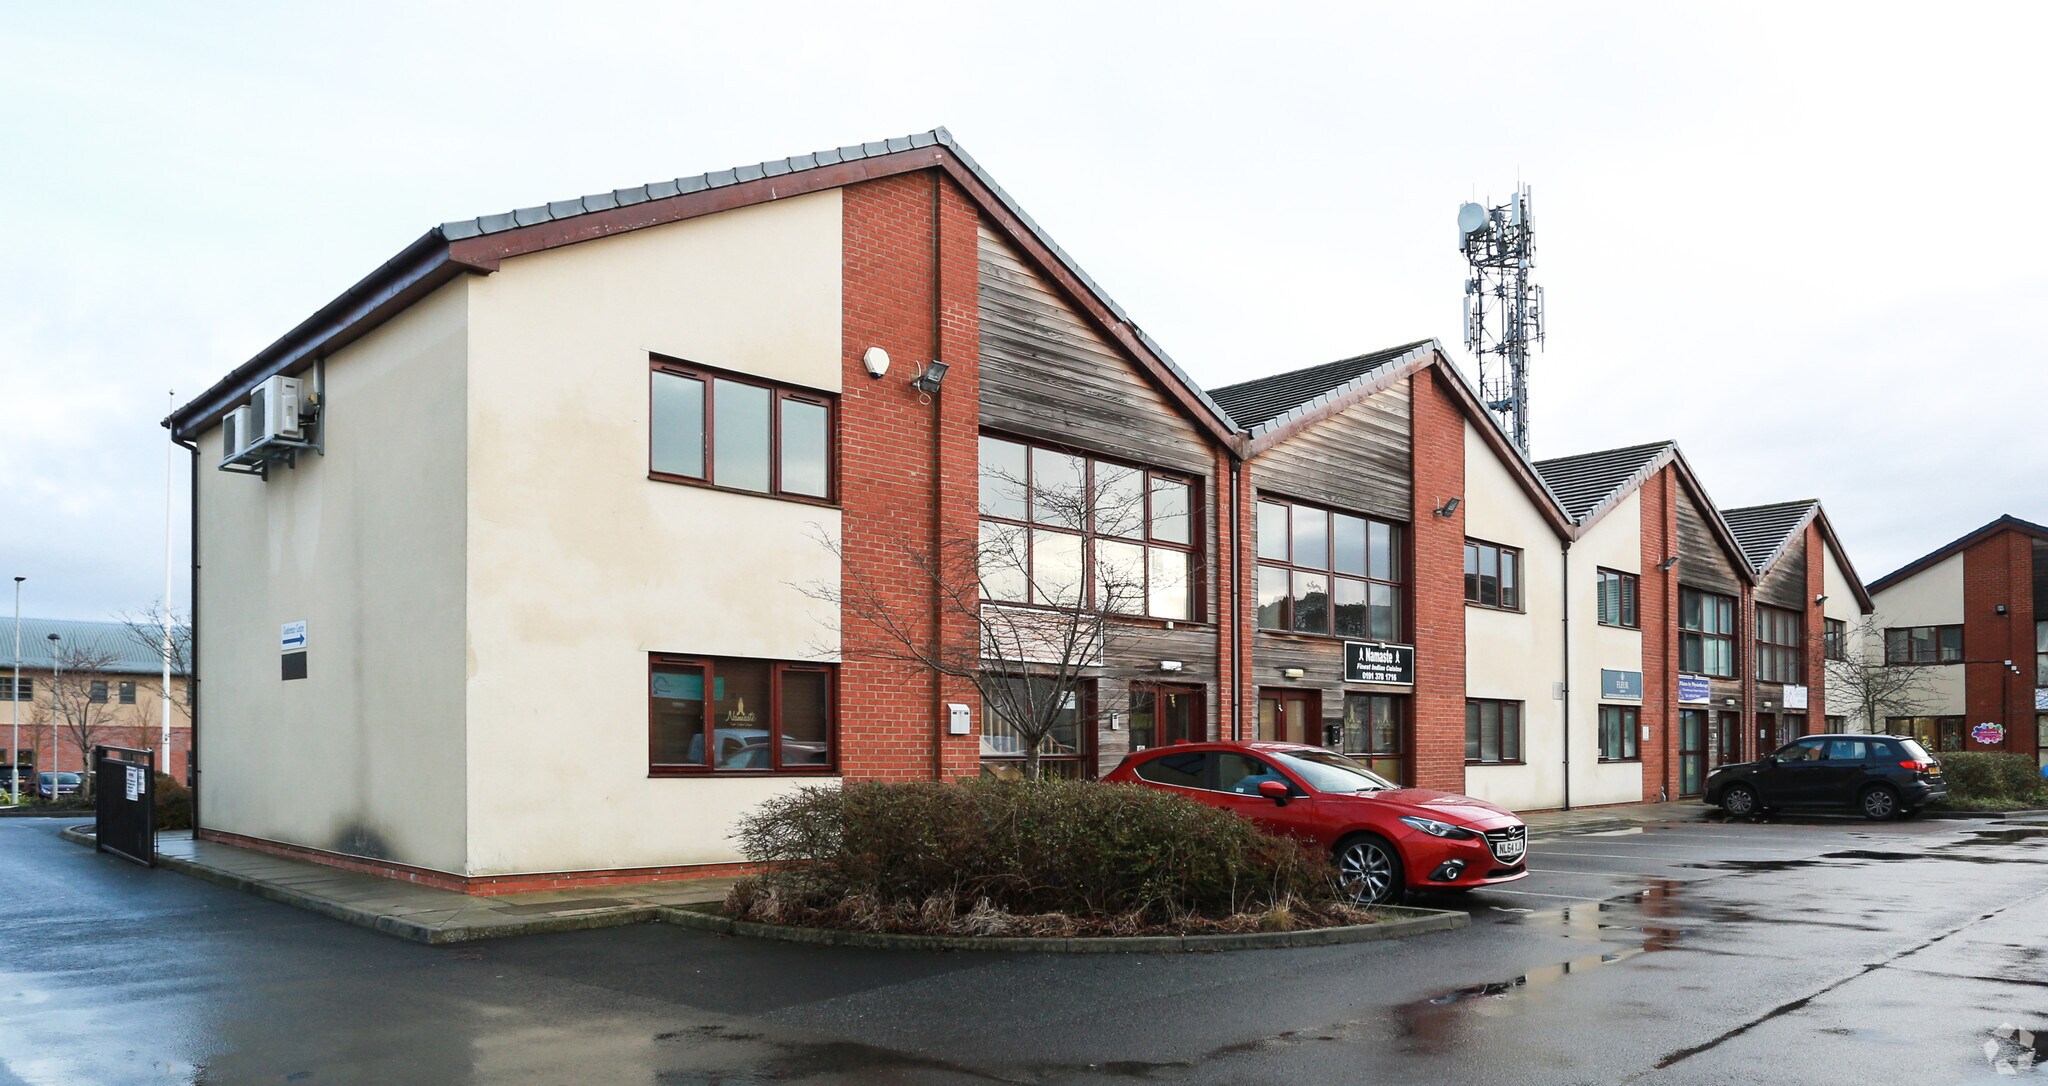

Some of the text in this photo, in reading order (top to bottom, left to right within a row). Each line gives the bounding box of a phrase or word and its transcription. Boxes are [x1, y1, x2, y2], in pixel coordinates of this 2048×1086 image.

[1365, 647, 1393, 664] Namaste
[1356, 662, 1371, 670] Finest
[1386, 665, 1402, 673] Cuisine
[1616, 680, 1629, 690] FLEUR
